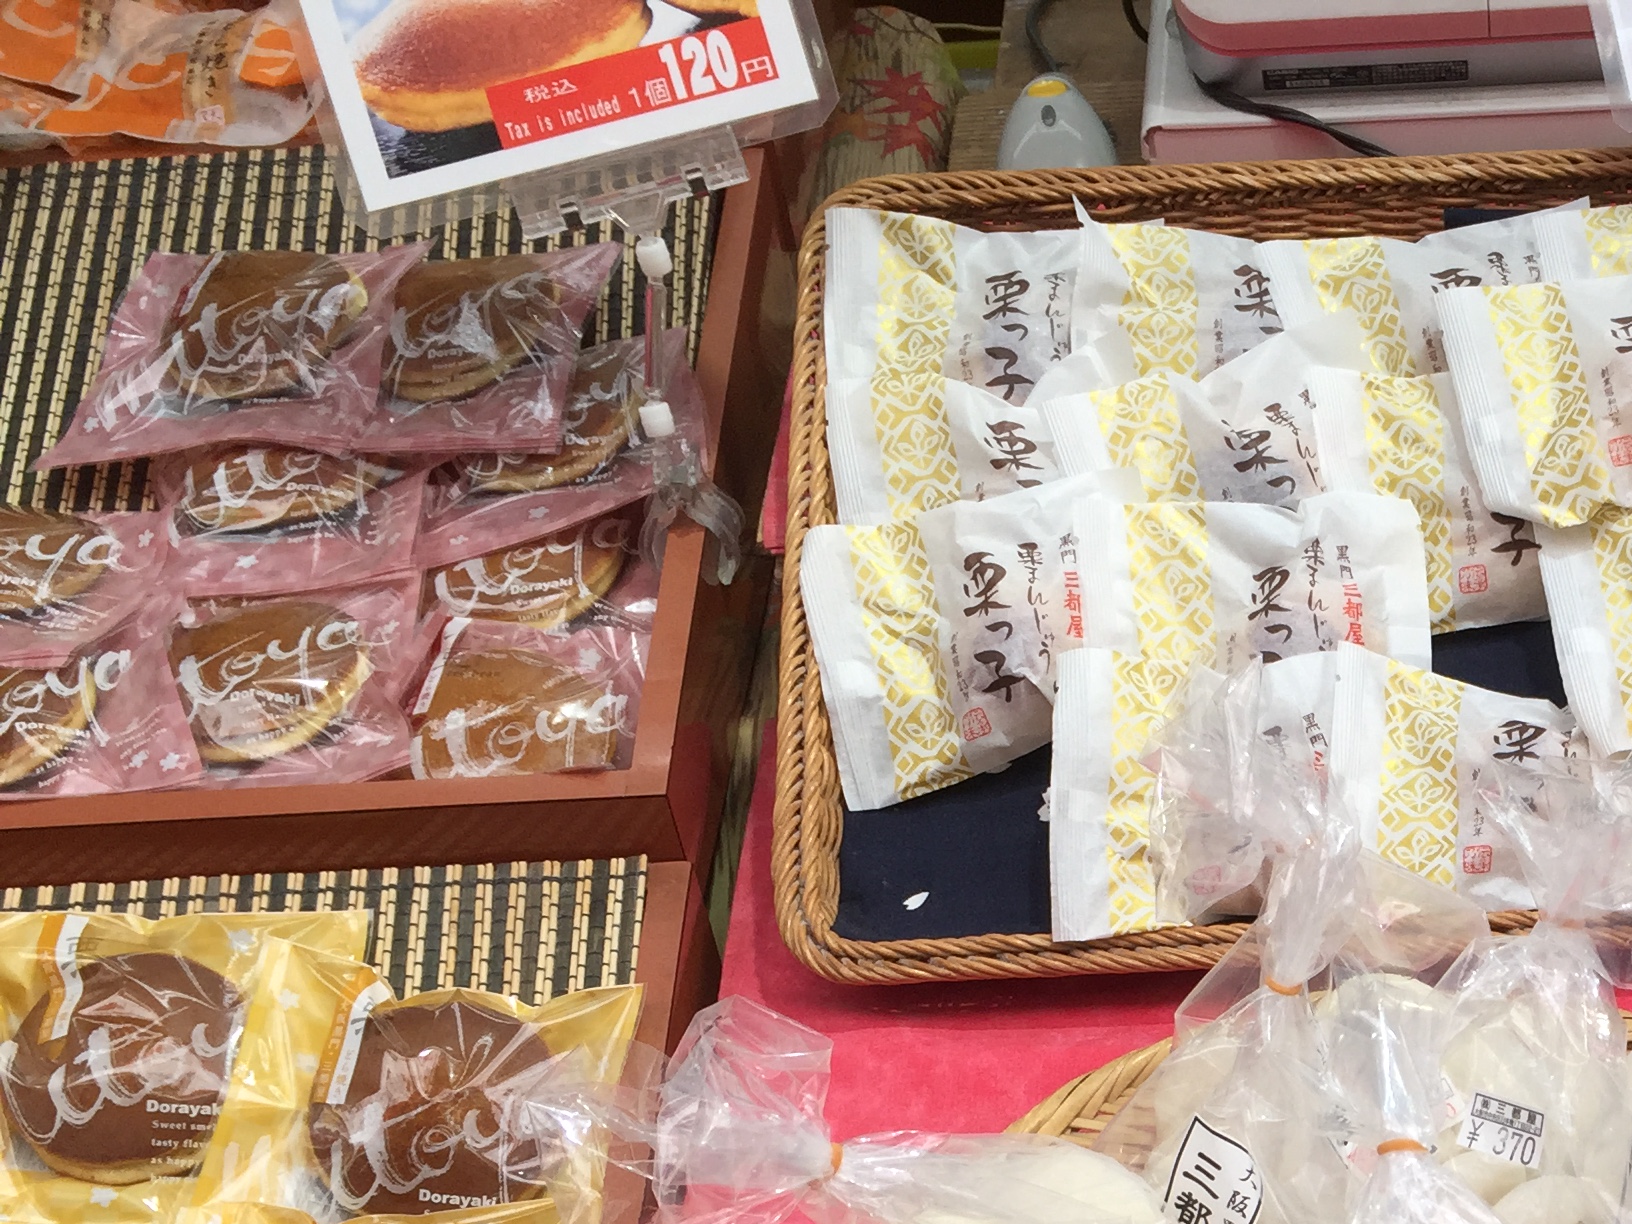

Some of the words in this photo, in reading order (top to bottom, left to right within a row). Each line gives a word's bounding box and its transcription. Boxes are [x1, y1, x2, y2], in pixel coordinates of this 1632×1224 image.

[523, 78, 579, 104] 税込
[504, 120, 531, 141] Tax
[537, 115, 554, 131] is
[560, 95, 621, 127] included
[983, 270, 1034, 399] 栗っ子
[1059, 533, 1079, 564] 黒門
[1336, 546, 1353, 579] 黒門
[510, 576, 573, 595] Dorayaki
[1018, 542, 1055, 674] 栗まんじゅう
[1064, 572, 1084, 638] 三都屋
[1342, 583, 1365, 646] 三都屋
[963, 552, 1026, 703] 栗っ子
[1302, 713, 1328, 749] 黒門
[146, 1100, 221, 1116] Dorayak
[152, 1120, 184, 1131] Sweet
[419, 1189, 496, 1207] Dorayaki
